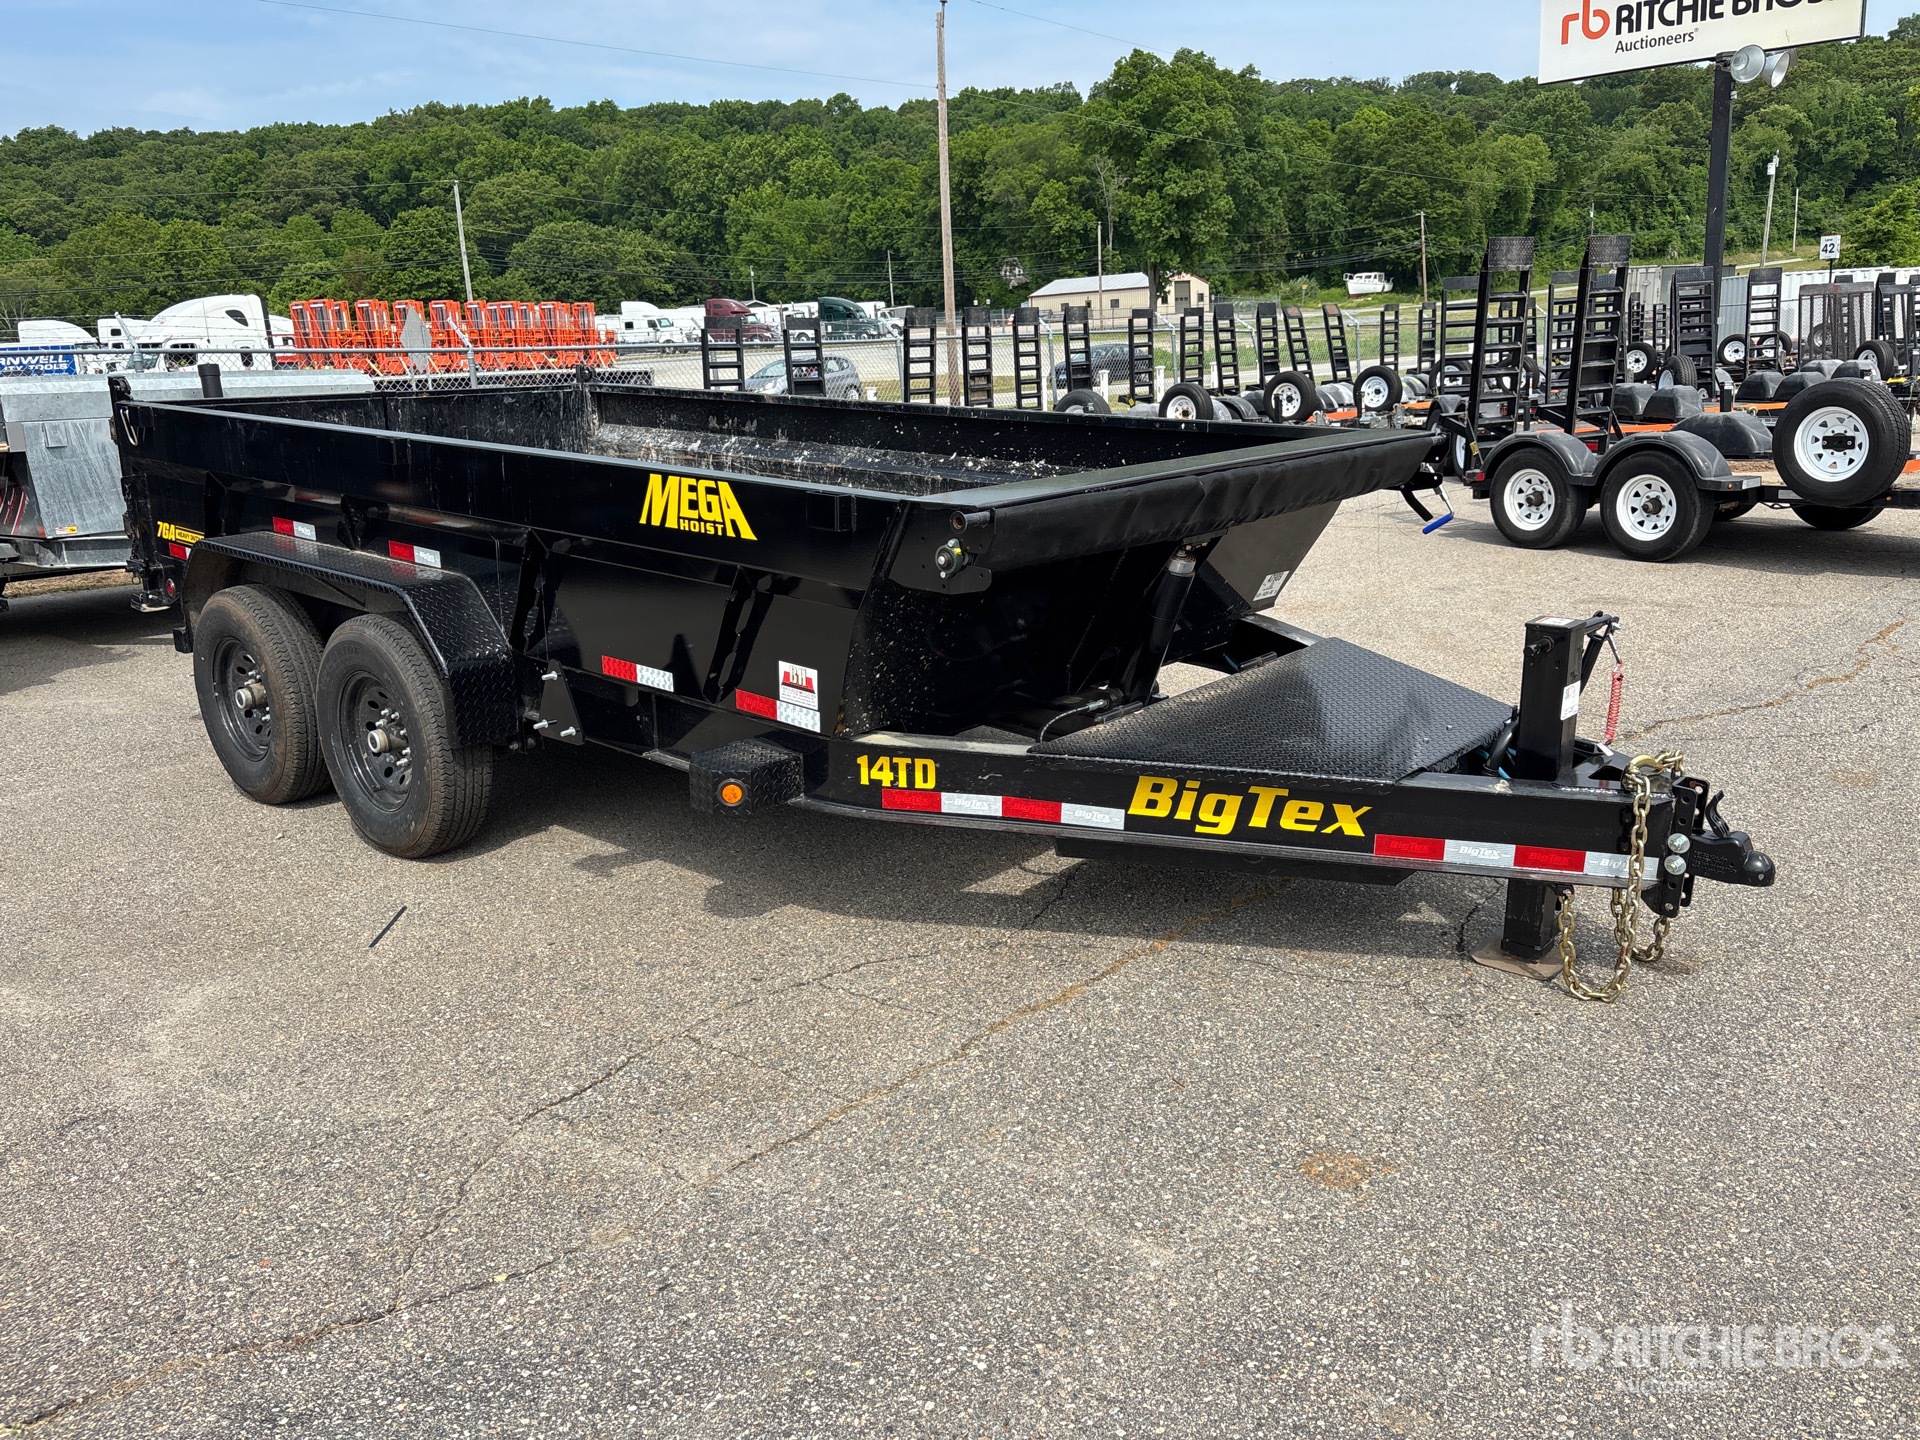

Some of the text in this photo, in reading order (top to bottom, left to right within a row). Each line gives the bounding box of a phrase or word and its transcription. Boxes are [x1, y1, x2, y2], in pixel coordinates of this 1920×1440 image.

[1615, 0, 1724, 35] RITCHIE
[1821, 243, 1836, 254] 42
[639, 473, 758, 540] MEGA
[157, 520, 176, 541] 7GA
[679, 519, 724, 536] HOIST
[857, 755, 936, 789] 14TD
[1074, 809, 1112, 823] BigTex
[1127, 775, 1373, 837] BigTex
[1459, 846, 1501, 860] BigTex
